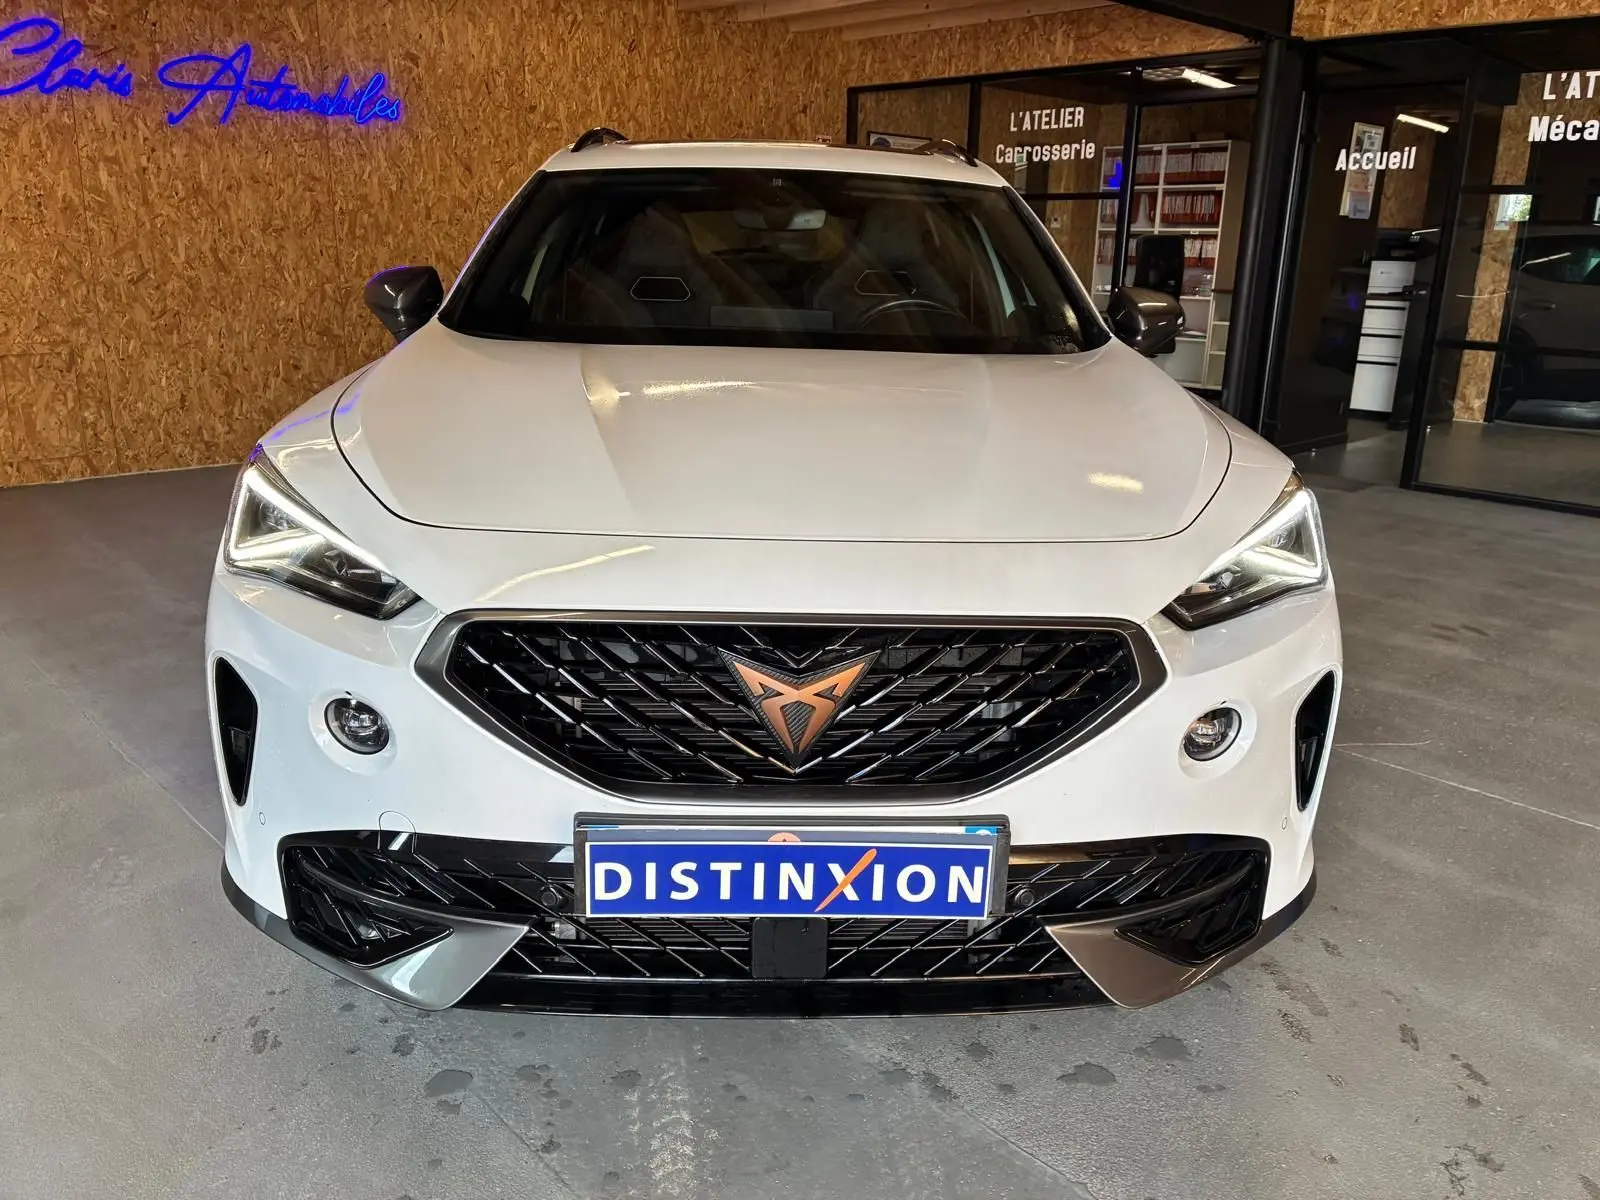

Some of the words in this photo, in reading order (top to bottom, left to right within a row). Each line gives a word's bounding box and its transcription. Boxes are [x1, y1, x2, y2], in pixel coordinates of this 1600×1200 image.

[157, 43, 401, 125] Automobiles
[1010, 106, 1084, 132] L'ATELIER
[1527, 114, 1600, 142] Méca
[995, 138, 1096, 164] Carrosserie
[1335, 146, 1417, 171] Accueil
[593, 848, 985, 913] DISTINXION
